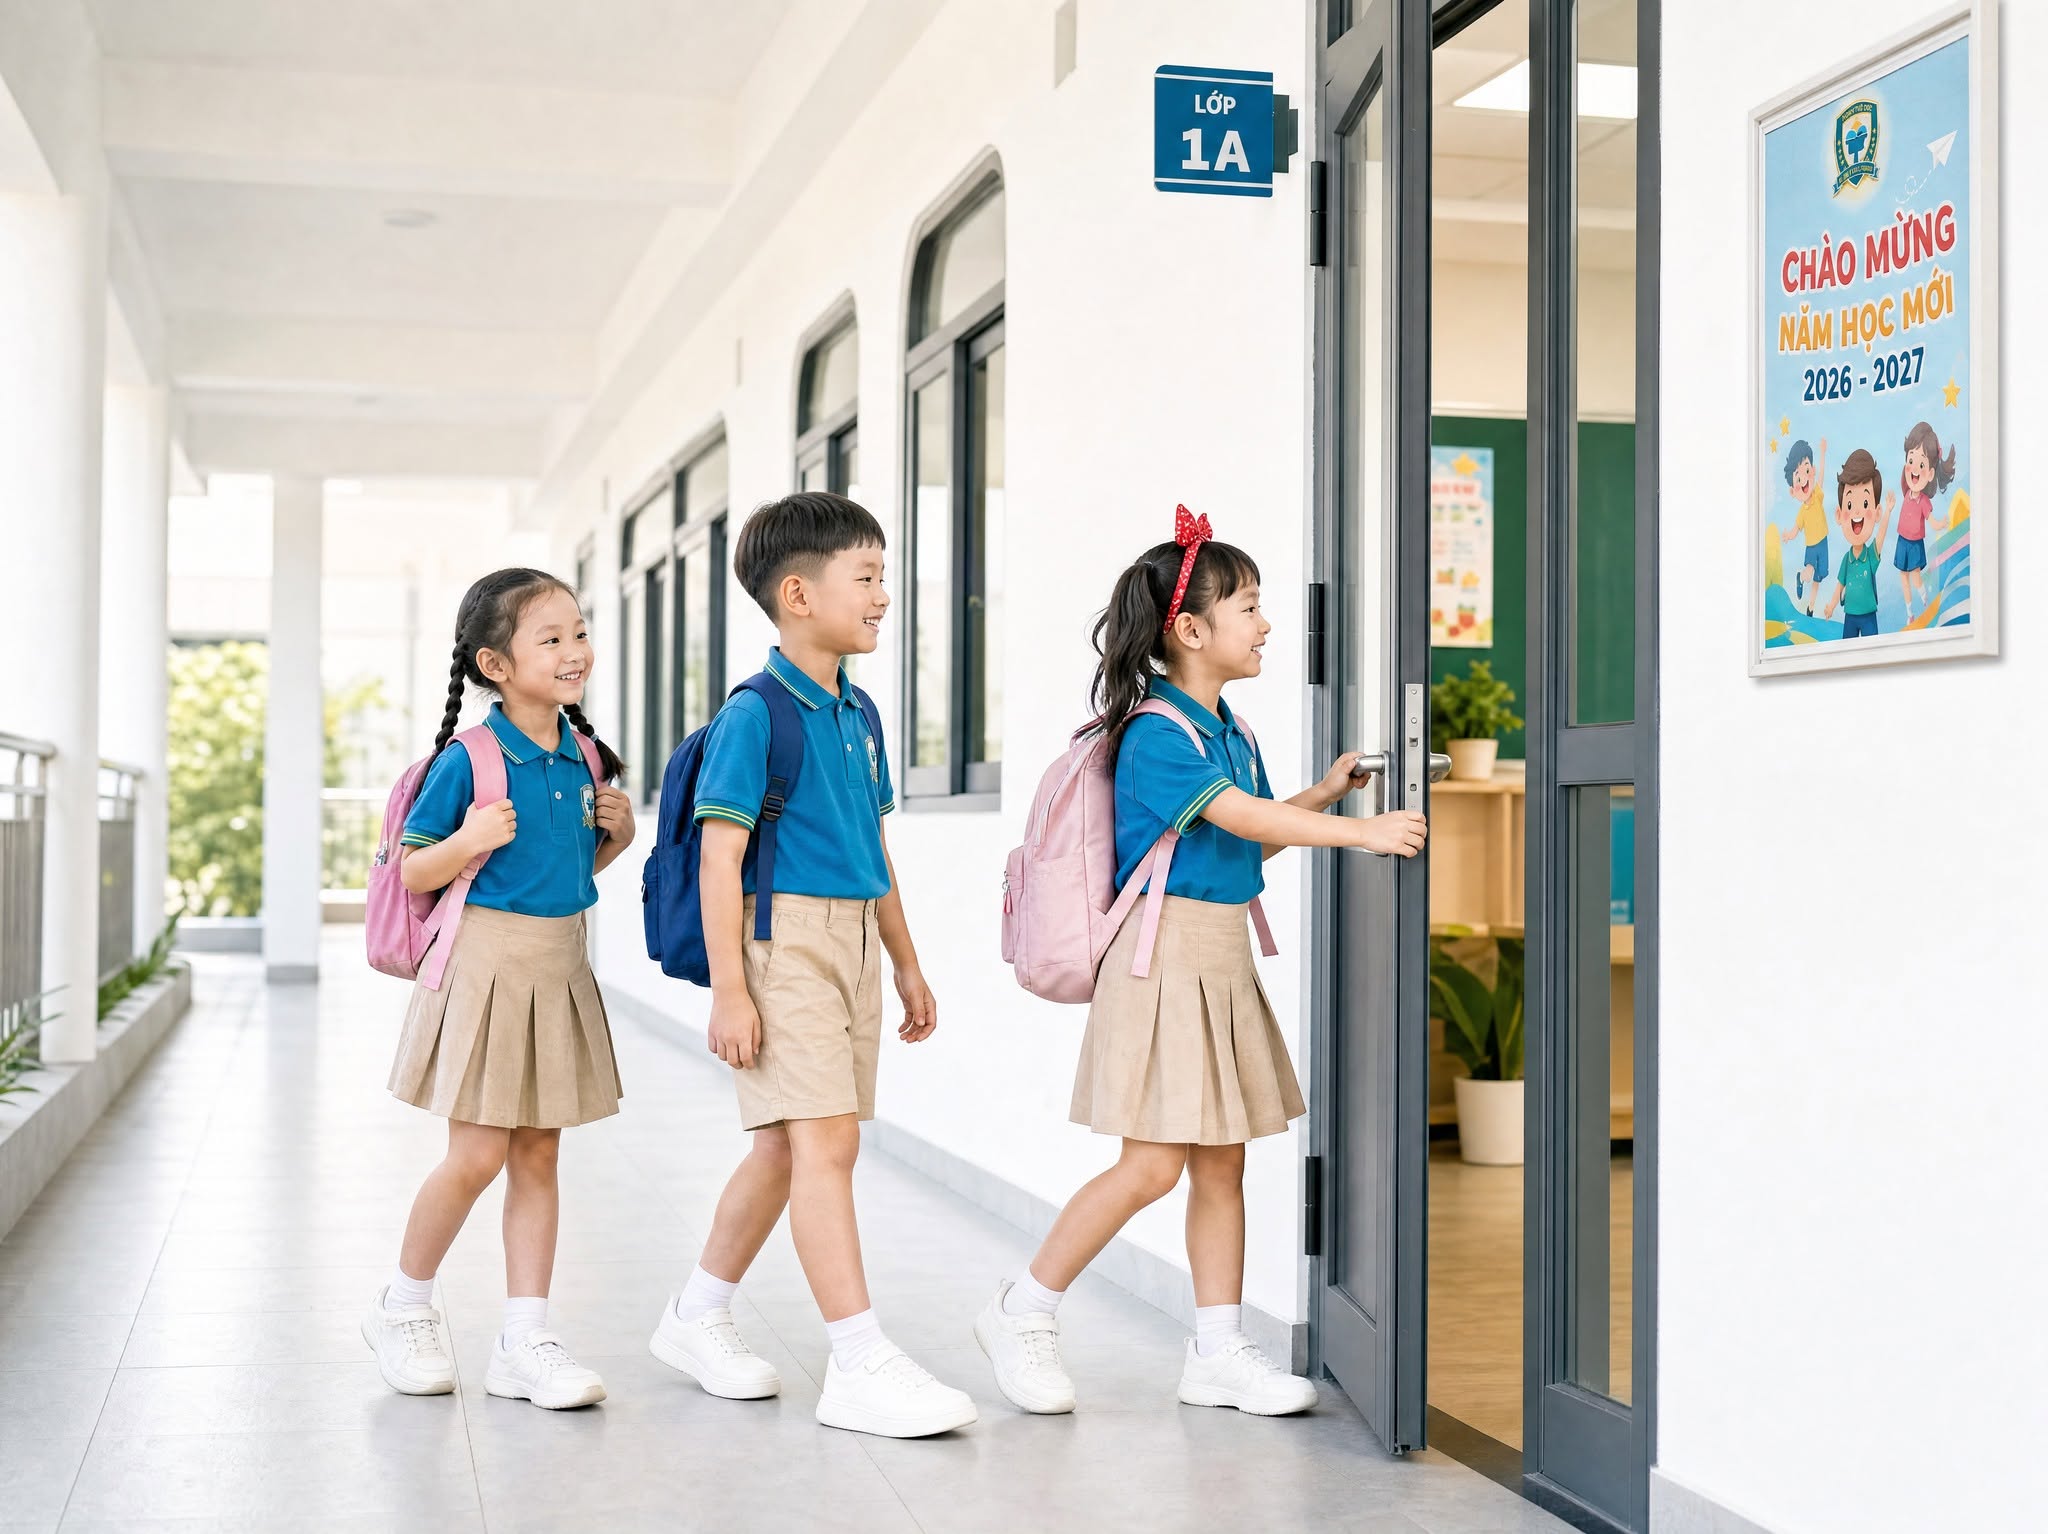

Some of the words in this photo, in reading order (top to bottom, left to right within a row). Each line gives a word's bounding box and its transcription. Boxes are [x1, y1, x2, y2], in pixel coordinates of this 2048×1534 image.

[1194, 90, 1237, 115] LỚP
[1181, 128, 1251, 173] 1A
[1782, 234, 1856, 293] CHÀO
[1866, 205, 1955, 279] MỪNG
[1779, 305, 1832, 351] NĂM
[1841, 298, 1894, 353] HỌC
[1903, 268, 1954, 330] MỚI
[1803, 365, 1852, 401] 2026
[1859, 377, 1867, 385] -
[1873, 347, 1924, 392] 2027
